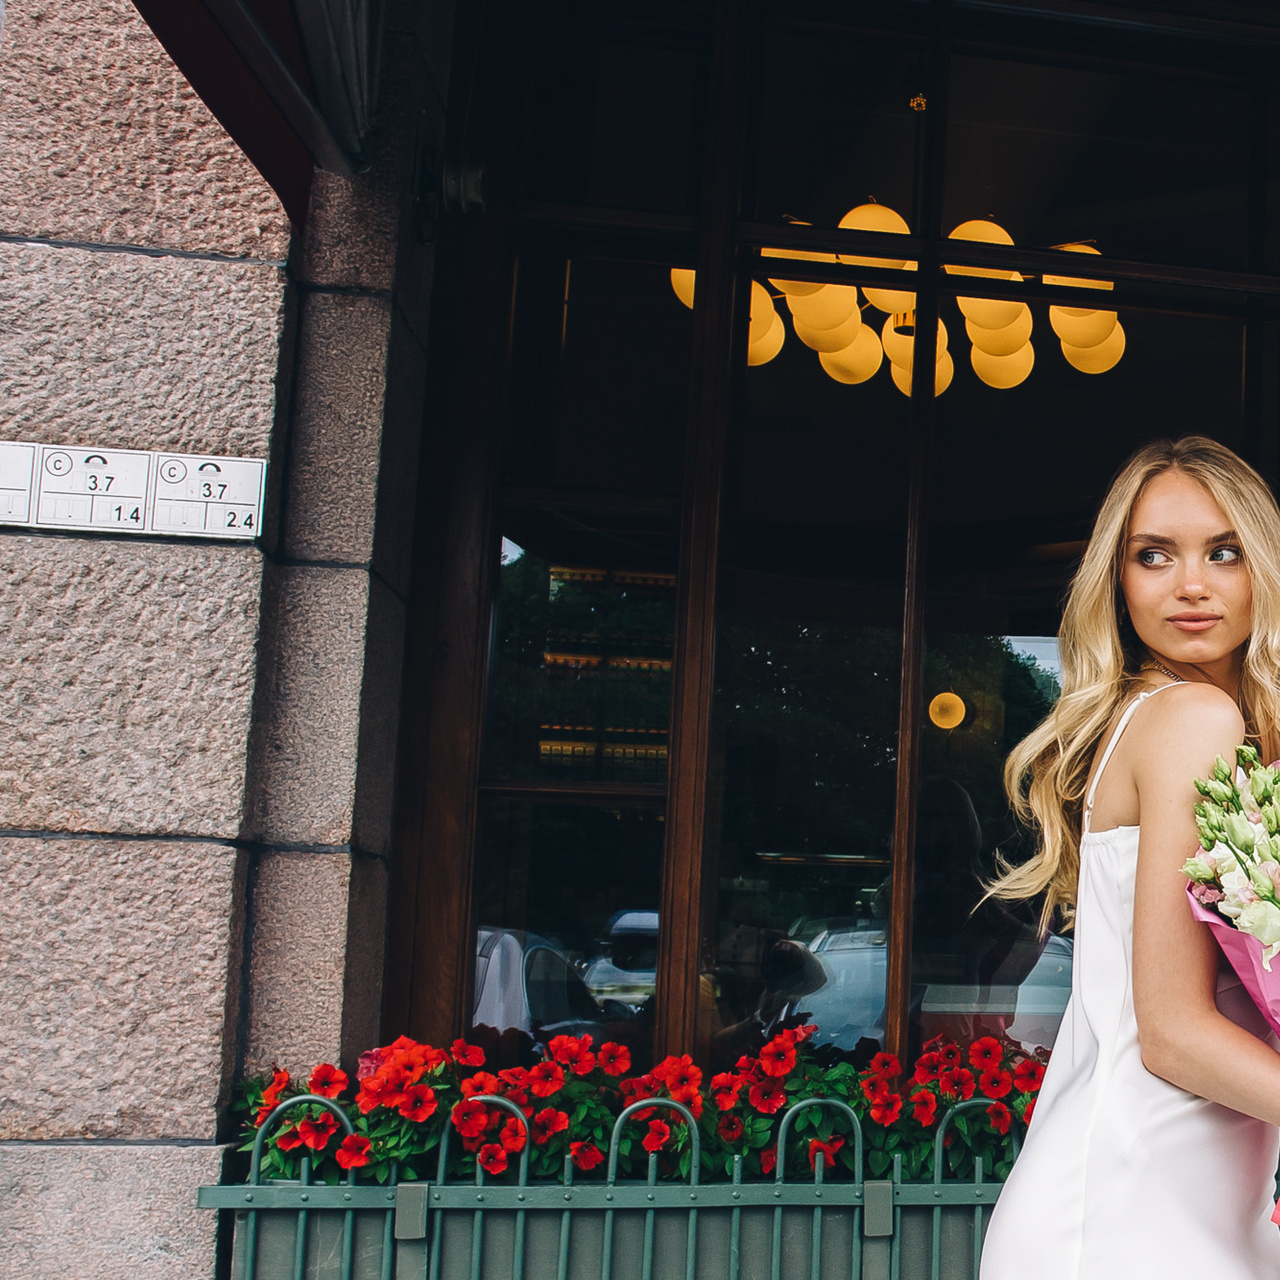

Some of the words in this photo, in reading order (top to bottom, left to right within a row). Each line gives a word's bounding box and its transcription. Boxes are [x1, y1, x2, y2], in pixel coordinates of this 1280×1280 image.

[88, 475, 115, 492] 3.7
[202, 483, 228, 500] 3.7
[114, 505, 141, 523] 1.4
[227, 511, 254, 529] 2.4
